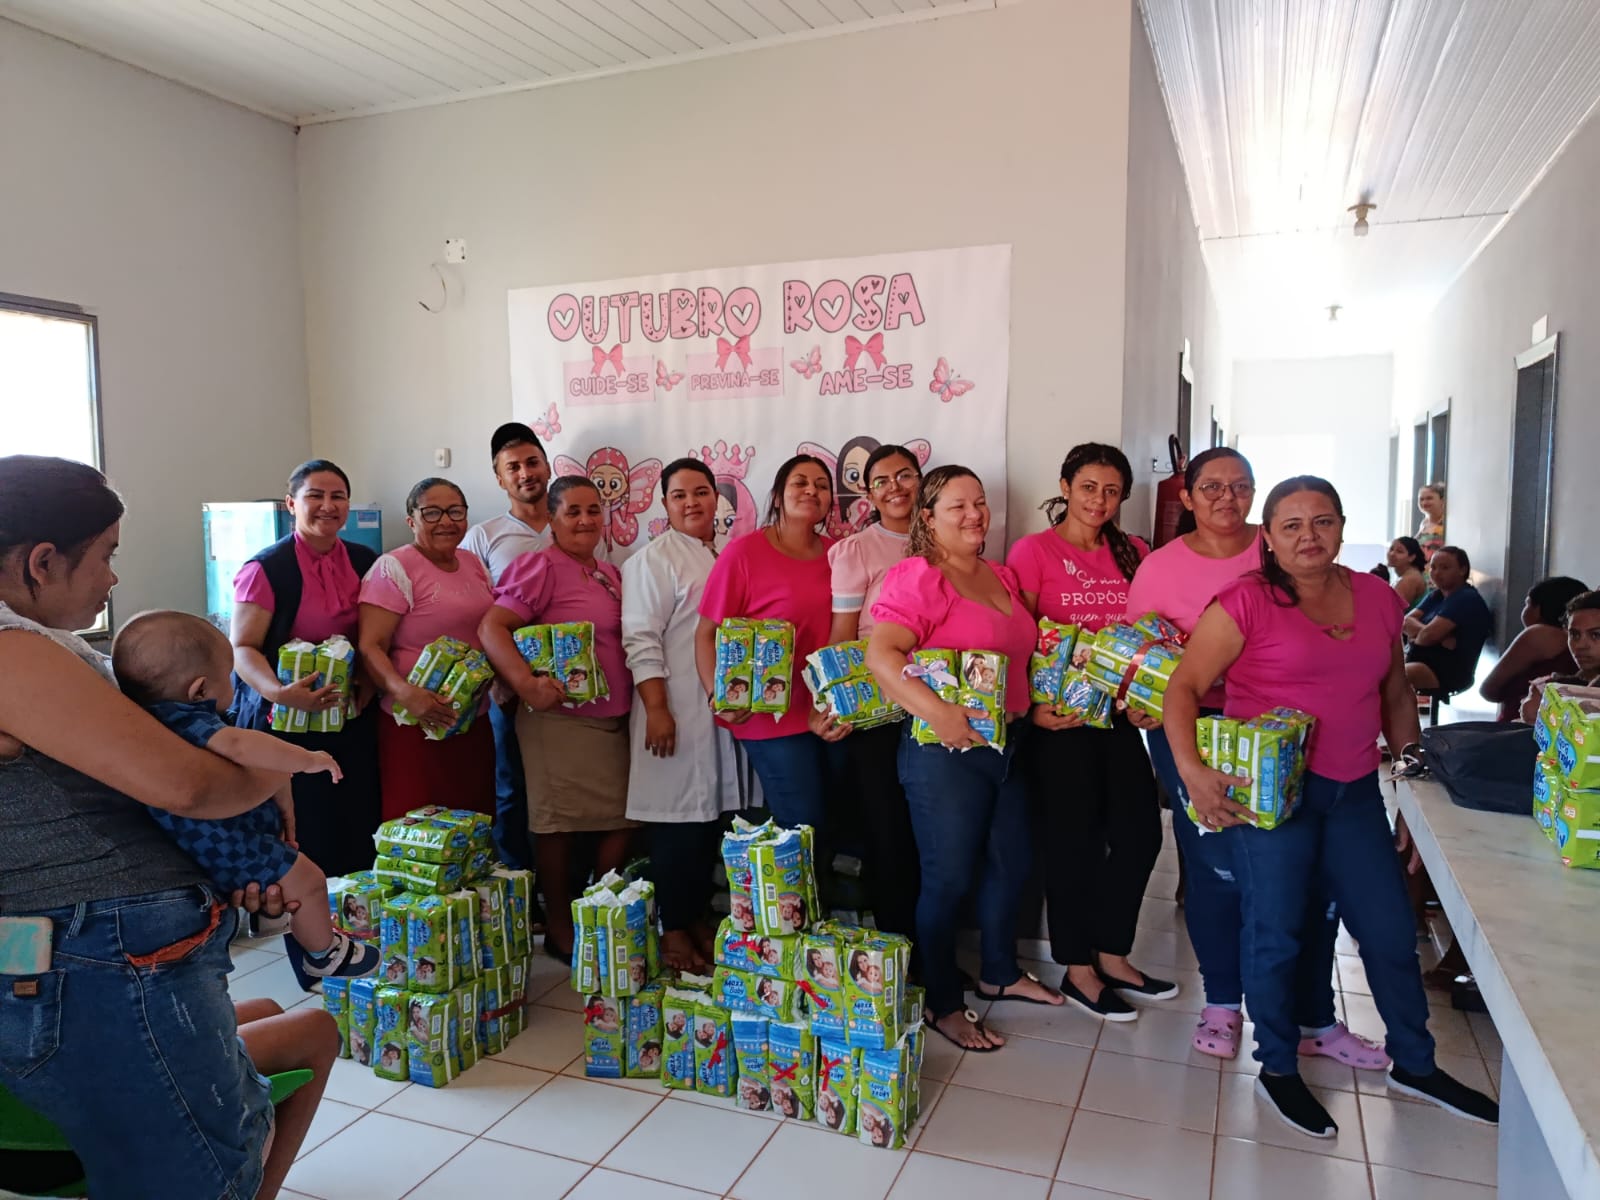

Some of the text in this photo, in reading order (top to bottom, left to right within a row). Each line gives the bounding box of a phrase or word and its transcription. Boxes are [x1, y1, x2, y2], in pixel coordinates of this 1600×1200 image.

[547, 273, 925, 344] OUTUBRO ROSA
[569, 373, 650, 397] CUIDE-SE
[690, 368, 780, 392] PREVINA-SE
[819, 364, 914, 396] AME-SE
